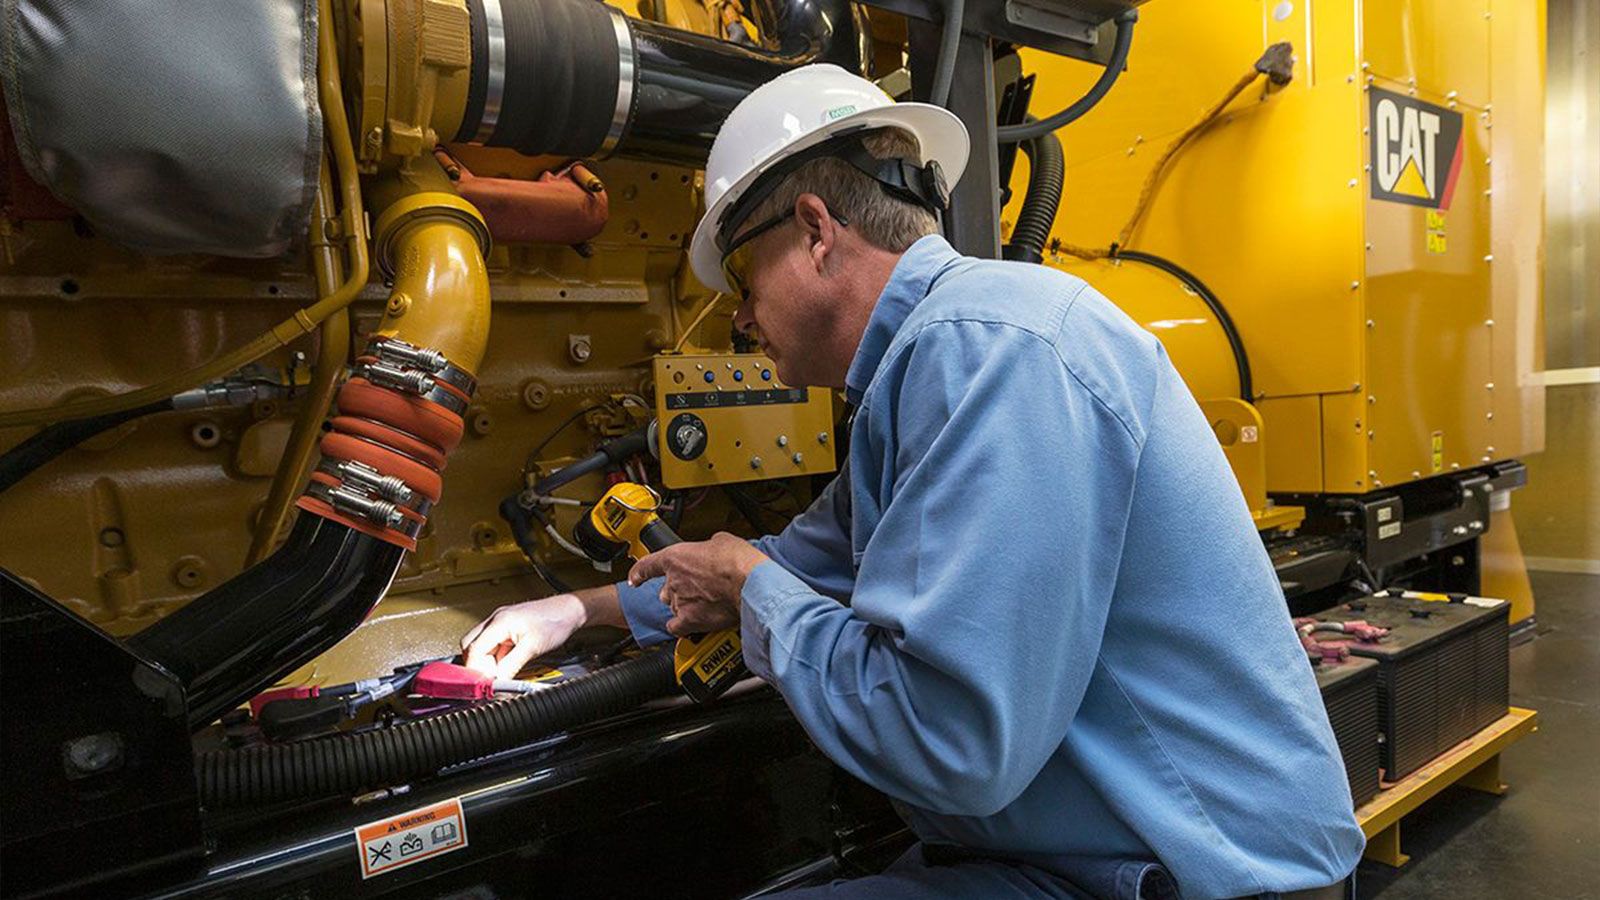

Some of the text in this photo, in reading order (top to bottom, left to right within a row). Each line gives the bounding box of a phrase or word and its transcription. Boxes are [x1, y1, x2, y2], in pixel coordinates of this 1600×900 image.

[1376, 99, 1440, 199] CAT
[702, 640, 734, 674] DEWALT
[400, 811, 436, 828] WARNING
